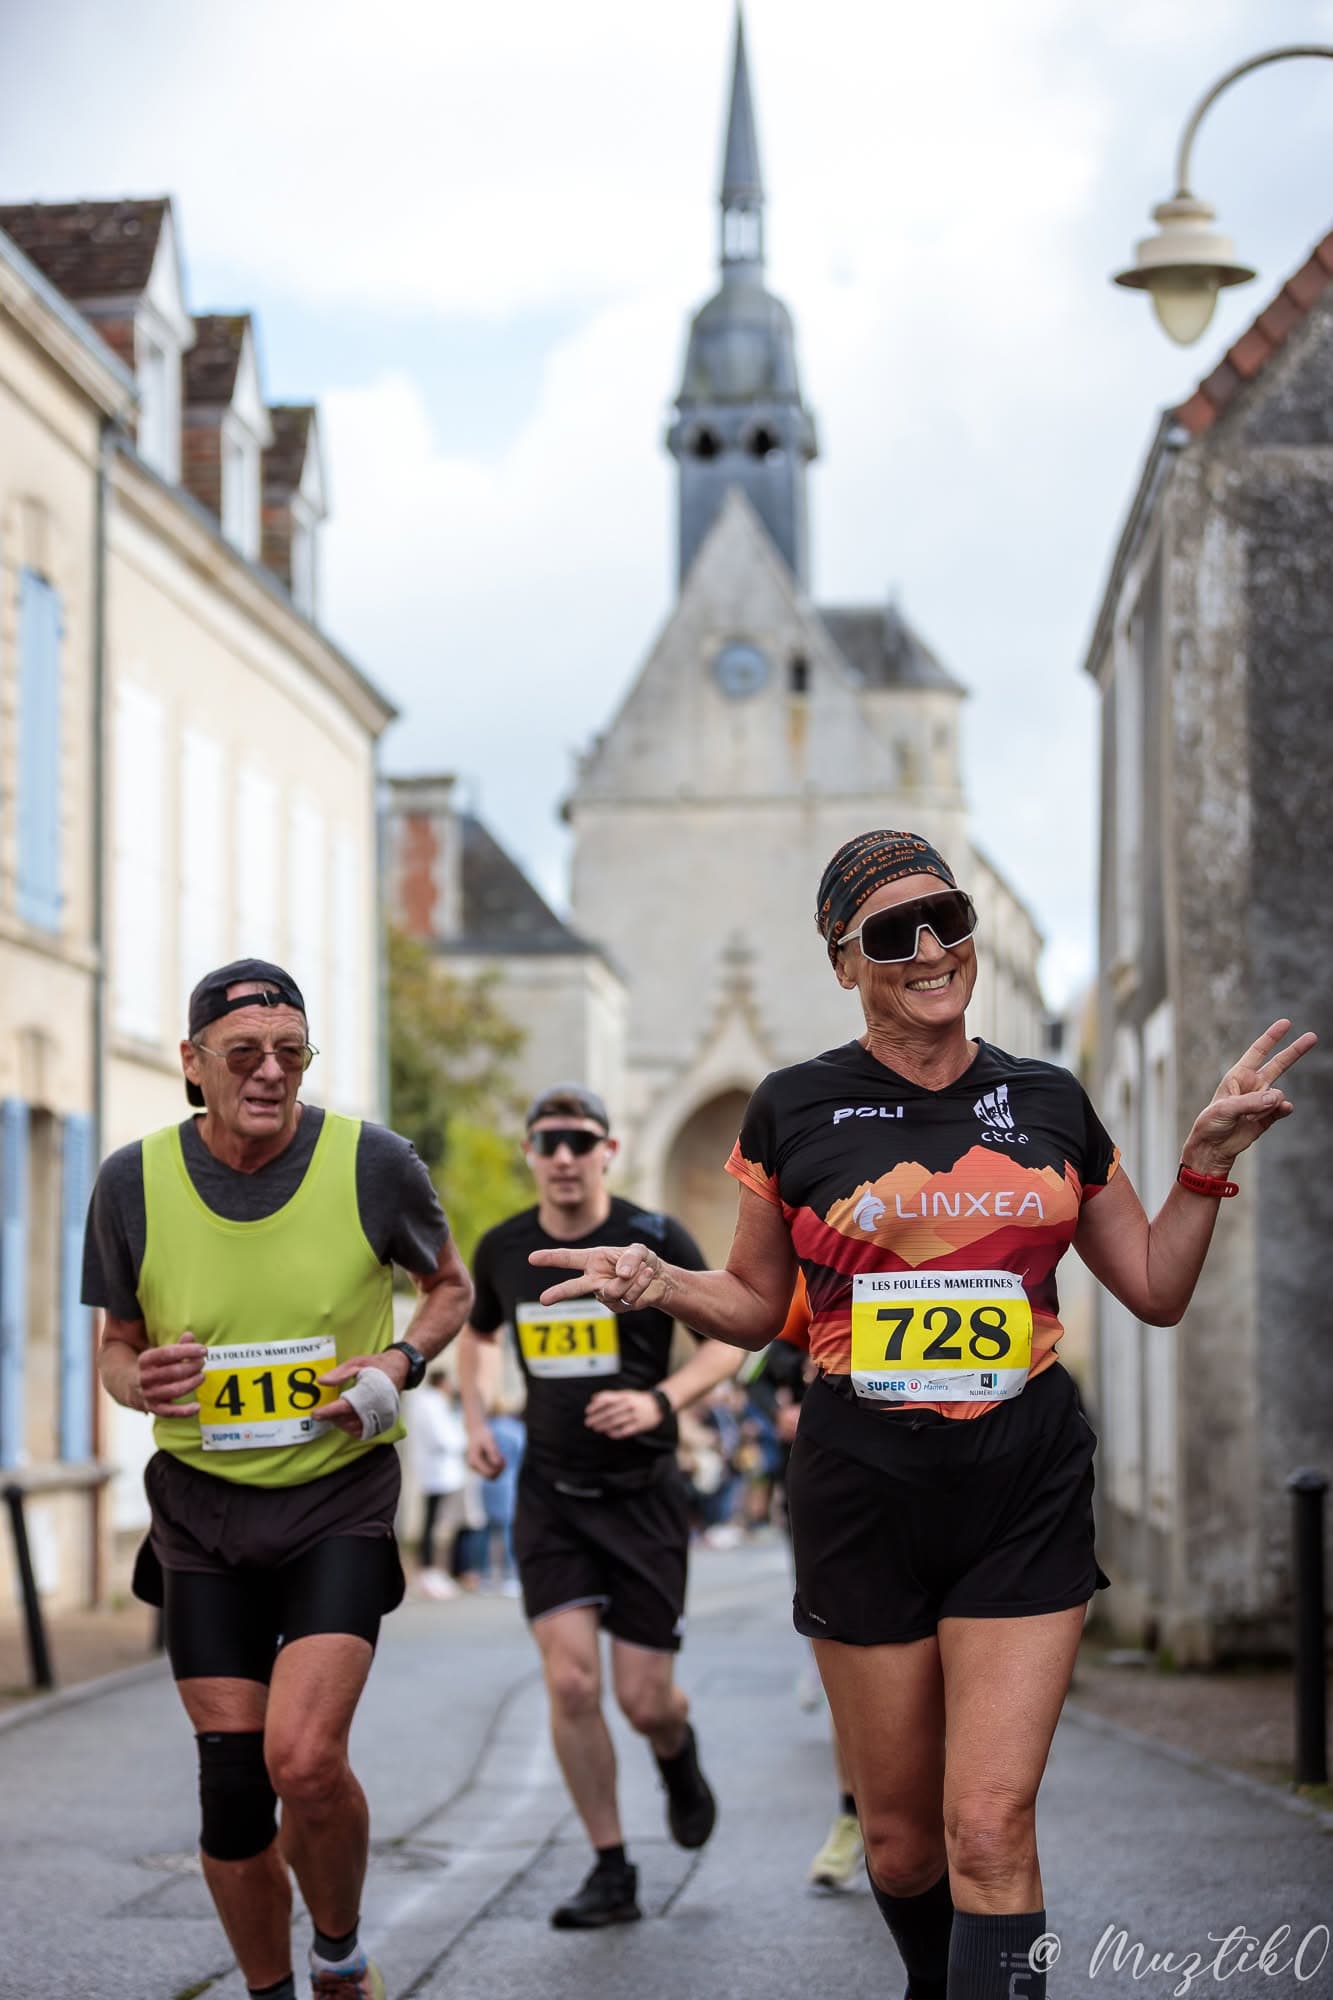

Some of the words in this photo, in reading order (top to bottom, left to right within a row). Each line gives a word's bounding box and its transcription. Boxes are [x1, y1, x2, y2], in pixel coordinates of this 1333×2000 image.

[843, 841, 912, 882] MERRELL
[856, 866, 924, 905] MERRELL
[833, 1106, 904, 1124] POLI
[895, 1191, 1045, 1219] LINXEA
[872, 1281, 891, 1291] LES
[894, 1277, 941, 1290] FOULÉES
[944, 1278, 1013, 1289] MAMERTINES
[533, 1323, 598, 1353] 731
[876, 1306, 1011, 1361] 728
[264, 1344, 321, 1356] MAMERTINES
[214, 1367, 321, 1416] 418
[867, 1380, 905, 1391] SUPER
[923, 1383, 949, 1391] Mamers
